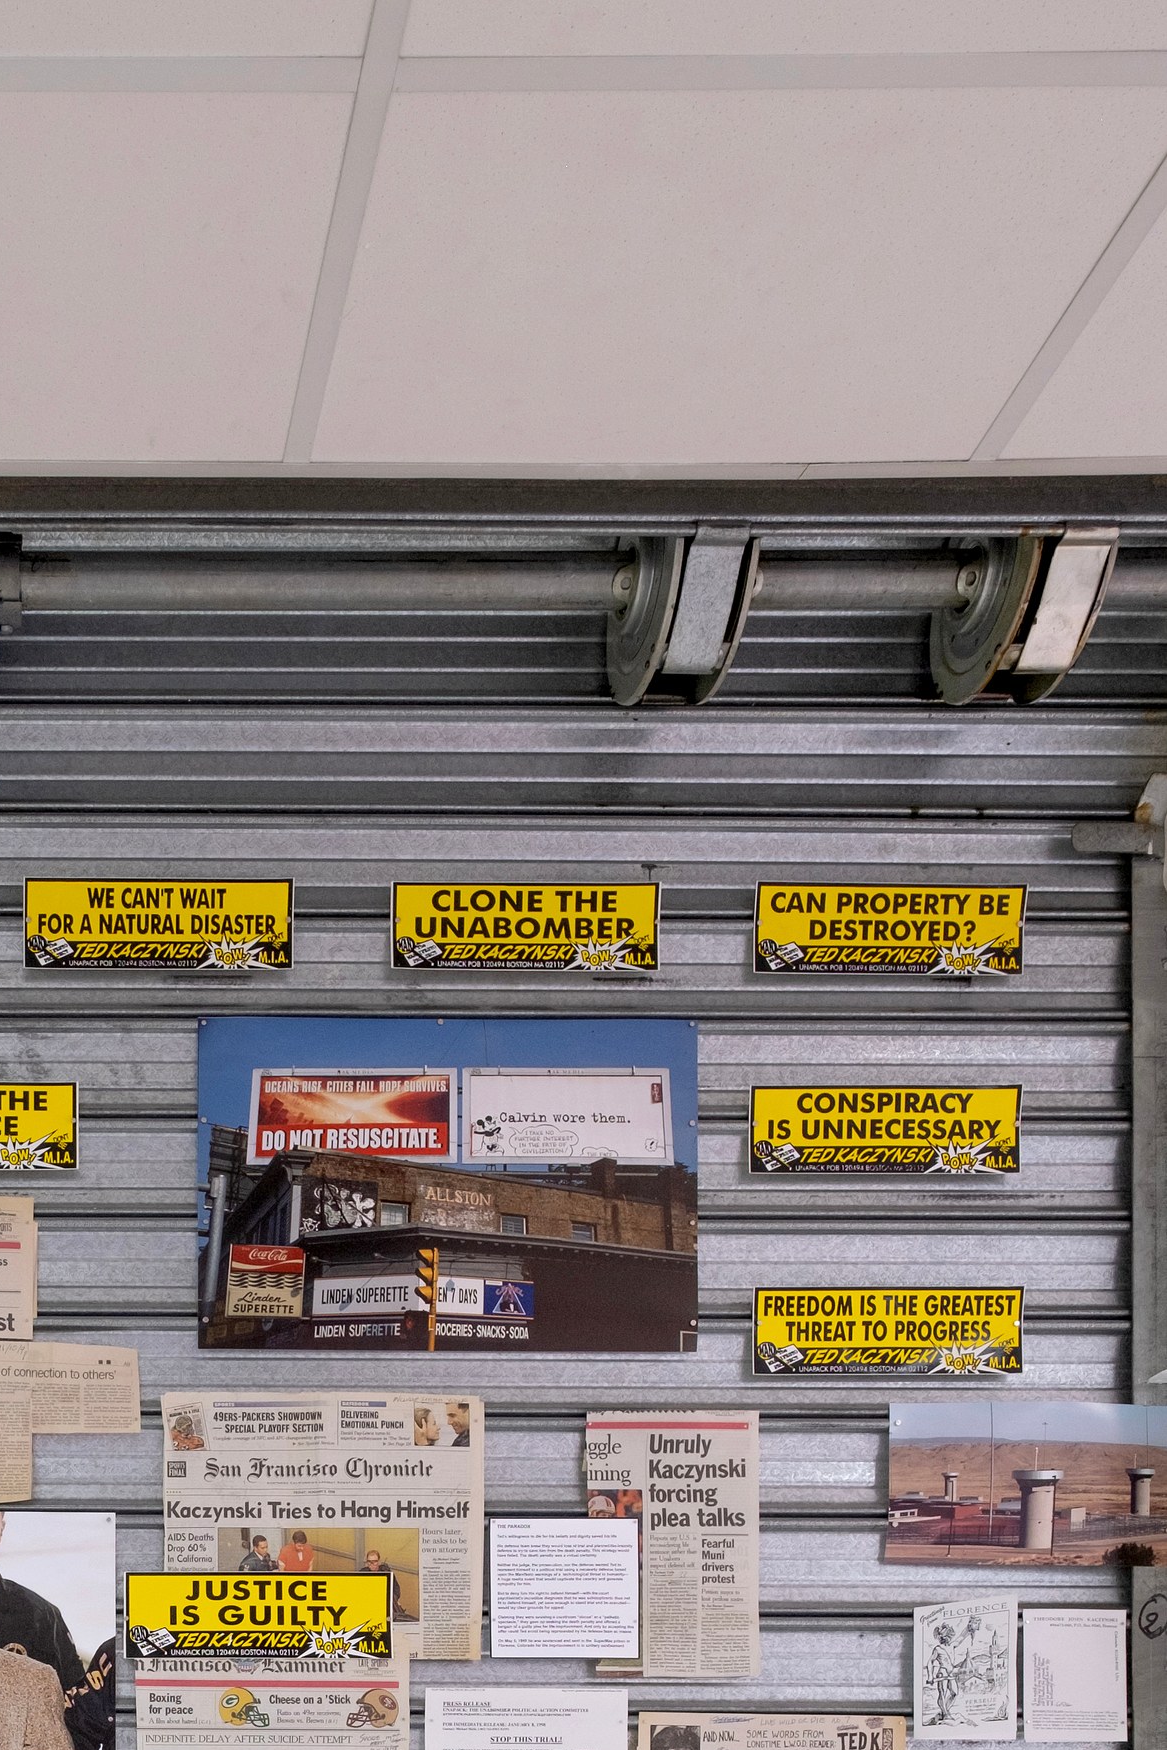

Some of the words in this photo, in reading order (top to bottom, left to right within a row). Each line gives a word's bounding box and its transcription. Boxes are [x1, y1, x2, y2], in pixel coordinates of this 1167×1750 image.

[88, 888, 114, 908] WE
[122, 888, 174, 909] CAN'T
[180, 888, 226, 909] WAIT
[432, 890, 542, 912] CLONE
[555, 891, 617, 912] THE
[771, 892, 826, 913] CAN
[837, 893, 970, 915] PROPERTY
[979, 895, 1010, 915] BE
[38, 914, 73, 934] FOR
[80, 914, 92, 934] A
[100, 914, 184, 934] NATURAL
[191, 914, 275, 937] DISASTER
[415, 917, 634, 940] UNABOMBER
[810, 920, 976, 944] DESTROYED?
[797, 1093, 973, 1113] CONSPIRACY
[500, 1111, 547, 1124] Calvin
[553, 1115, 586, 1124] wore
[592, 1112, 631, 1124] them.
[768, 1120, 791, 1142] IS
[802, 1119, 1000, 1140] UNNECESSARY
[764, 1295, 852, 1316] FREEDOM
[860, 1295, 876, 1316] IS
[883, 1295, 917, 1315] THE
[925, 1295, 1015, 1316] GREATEST
[786, 1321, 856, 1341] THREAT
[862, 1320, 887, 1341] TO
[895, 1321, 990, 1344] PROGRESS
[650, 1434, 711, 1458] Unruly
[649, 1459, 745, 1482] Kaczynski
[649, 1484, 717, 1506] forcing
[167, 1501, 261, 1522] Kaczynski
[268, 1502, 311, 1519] Tries
[317, 1504, 336, 1518] to
[341, 1501, 391, 1523] Hang
[397, 1501, 469, 1518] Himself
[651, 1508, 690, 1530] plea
[697, 1508, 745, 1527] talks
[186, 1580, 326, 1601] JUSTICE
[170, 1605, 199, 1625] IS
[218, 1605, 347, 1626] GUILTY
